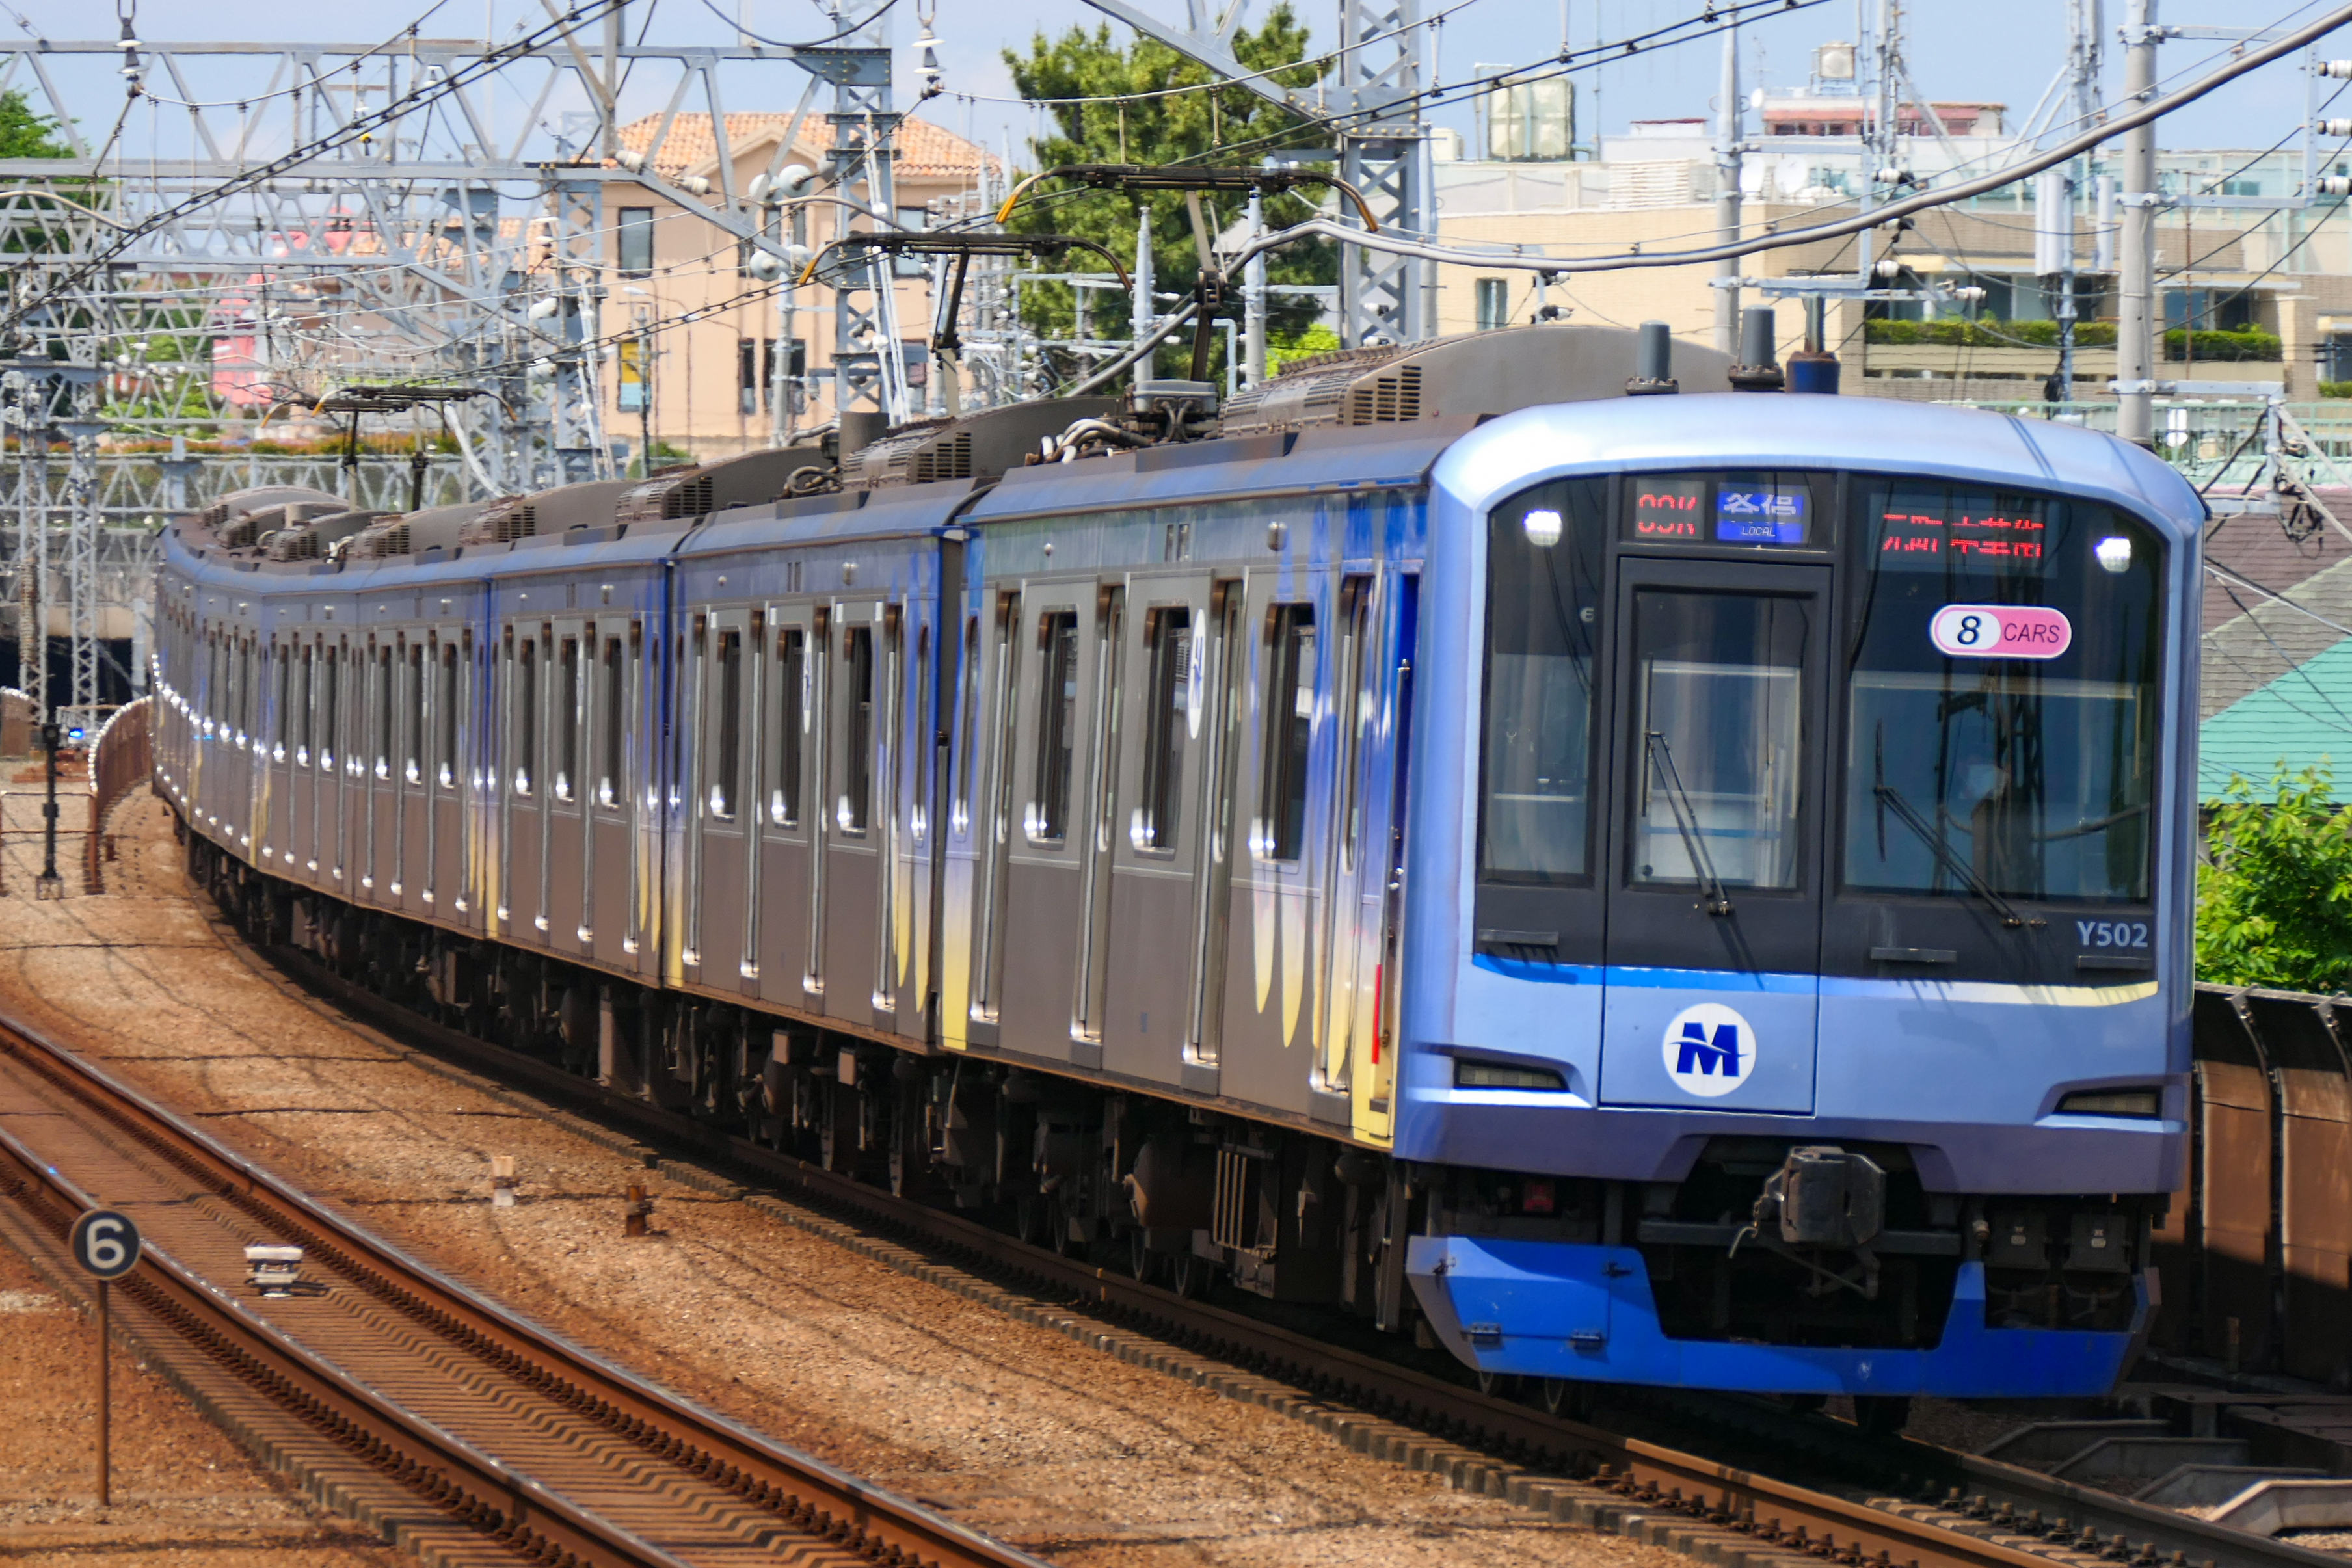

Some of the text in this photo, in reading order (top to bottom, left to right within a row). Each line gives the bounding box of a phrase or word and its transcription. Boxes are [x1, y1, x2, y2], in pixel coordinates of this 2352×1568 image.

[1724, 492, 1797, 523] 各停
[1741, 525, 1776, 537] LOCAL
[1957, 615, 2061, 646] 8 CARS
[2076, 920, 2149, 948] Y502
[1669, 1022, 1750, 1078] M
[86, 1217, 126, 1270] 6
